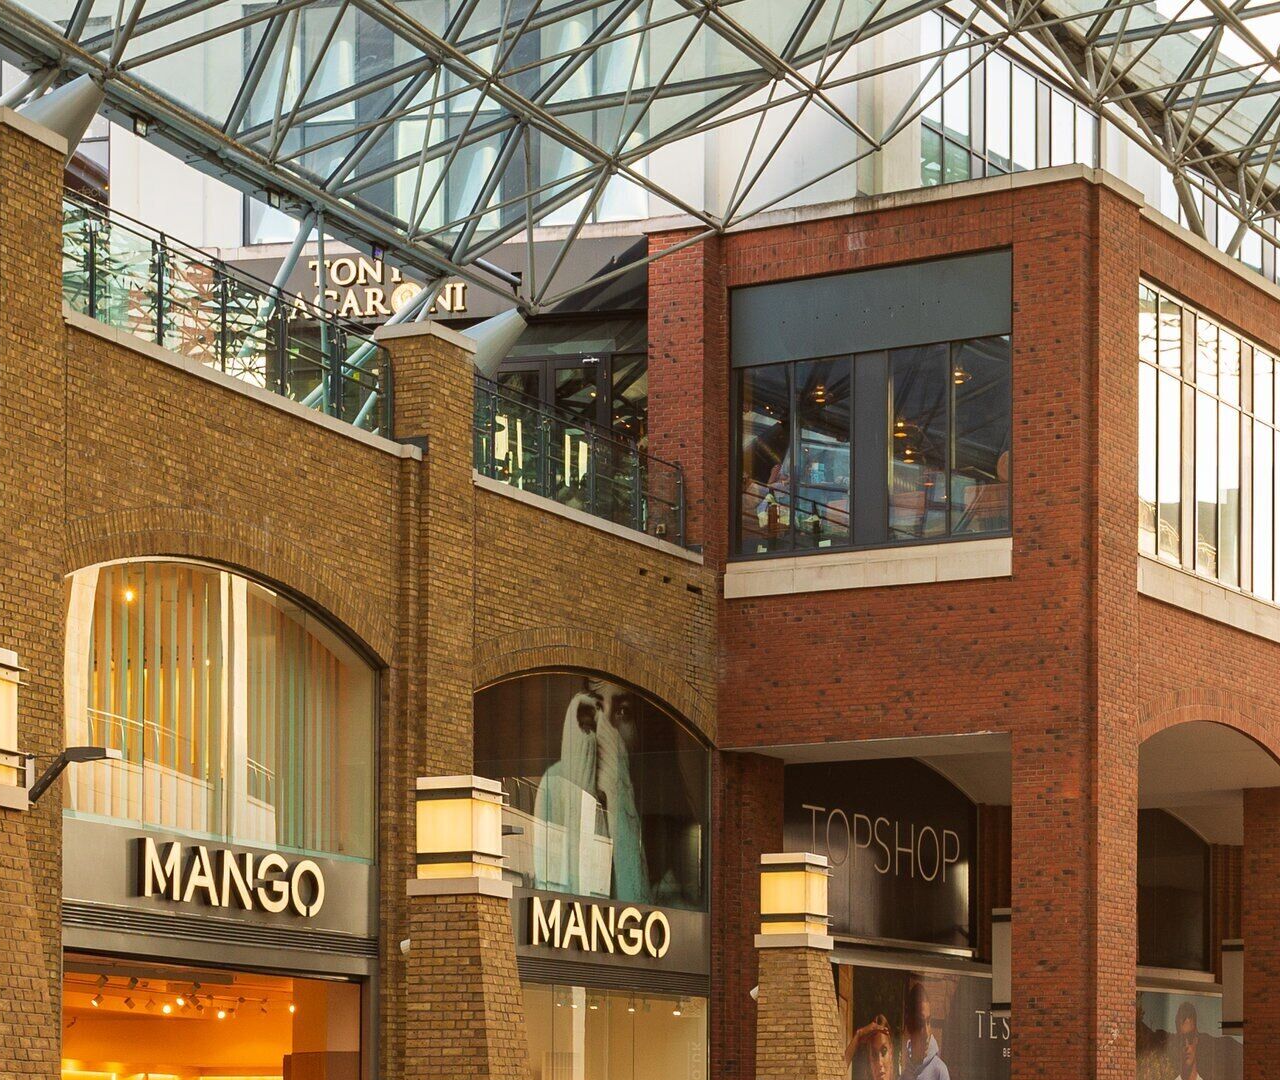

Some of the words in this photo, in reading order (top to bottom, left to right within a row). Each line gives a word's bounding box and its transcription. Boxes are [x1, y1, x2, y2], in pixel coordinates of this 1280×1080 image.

[287, 282, 467, 322] ACARONI
[137, 837, 325, 918] MANGO
[802, 804, 960, 883] TOPSHOP
[527, 897, 671, 958] MANGO
